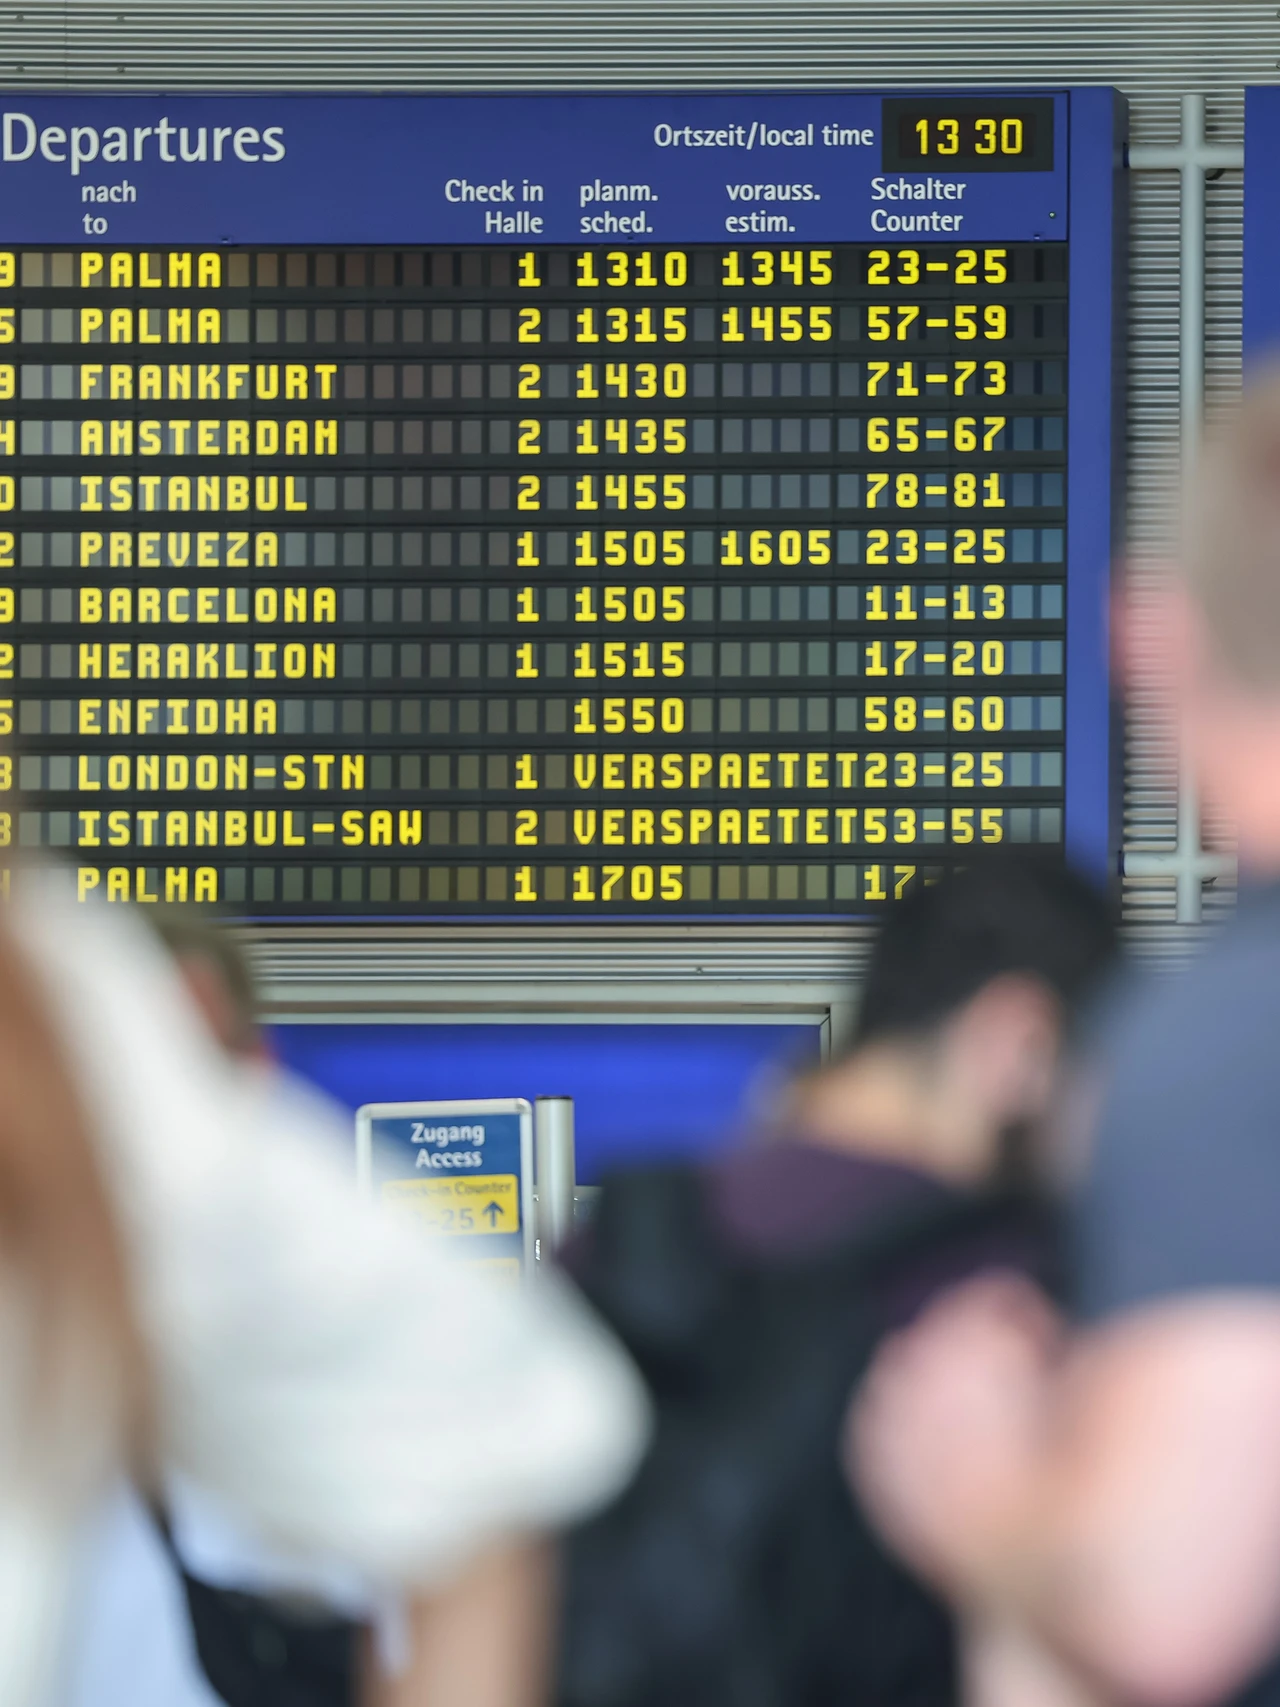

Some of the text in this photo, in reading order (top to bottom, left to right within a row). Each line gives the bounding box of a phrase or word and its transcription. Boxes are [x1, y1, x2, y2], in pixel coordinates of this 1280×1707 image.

[3, 112, 286, 176] Departures
[654, 119, 874, 151] Ortszeit/local time
[81, 179, 137, 203] nach
[445, 179, 544, 203] Check in
[580, 178, 658, 206] planm.
[725, 182, 821, 201] vorauss.
[871, 177, 967, 201] Schalter
[82, 213, 108, 235] to
[485, 210, 543, 234] Halle
[580, 209, 653, 234] sched.
[725, 209, 796, 233] estim.
[871, 208, 964, 232] Counter
[81, 253, 220, 286] PALMA
[518, 253, 540, 286] 1
[576, 252, 686, 286] 1310
[722, 251, 832, 285] 1345
[867, 250, 1006, 284] 23-25
[81, 309, 220, 342] PALMA
[518, 309, 540, 342] 2
[576, 308, 686, 342] 1315
[722, 307, 832, 341] 1455
[867, 306, 1006, 340] 57-59
[81, 365, 337, 398] FRANKFURT
[517, 365, 539, 398] 2
[575, 364, 685, 398] 1430
[866, 362, 1005, 396] 71-73
[82, 420, 337, 454] AMSTERDAM
[517, 420, 539, 454] 2
[575, 419, 685, 454] 1435
[866, 417, 1005, 452] 65-67
[82, 476, 307, 510] ISTANBUL
[517, 476, 539, 510] 2
[575, 475, 685, 510] 1455
[866, 473, 1005, 508] 78-81
[81, 532, 277, 566] PREVEZA
[516, 532, 538, 566] 1
[574, 531, 684, 566] 1505
[722, 530, 832, 565] 1605
[866, 529, 1005, 564] 23-25
[80, 588, 335, 622] BARCELONA
[516, 588, 538, 622] 1
[574, 587, 684, 622] 1505
[865, 585, 1004, 620] 11-13
[80, 644, 335, 677] HERAKLION
[516, 644, 538, 677] 1
[574, 643, 684, 677] 1515
[865, 641, 1004, 675] 17-20
[80, 700, 276, 734] ENFIDHA
[574, 699, 684, 734] 1550
[865, 697, 1004, 732] 58-60
[79, 756, 363, 790] LONDON-STN
[515, 756, 537, 790] 1
[79, 812, 421, 846] ISTANBUL-SAW
[515, 812, 537, 846] 2
[79, 867, 217, 901] PALMA
[514, 867, 536, 901] 1
[573, 866, 683, 901] 1705
[410, 1122, 485, 1148] Zugang
[416, 1148, 483, 1169] Access
